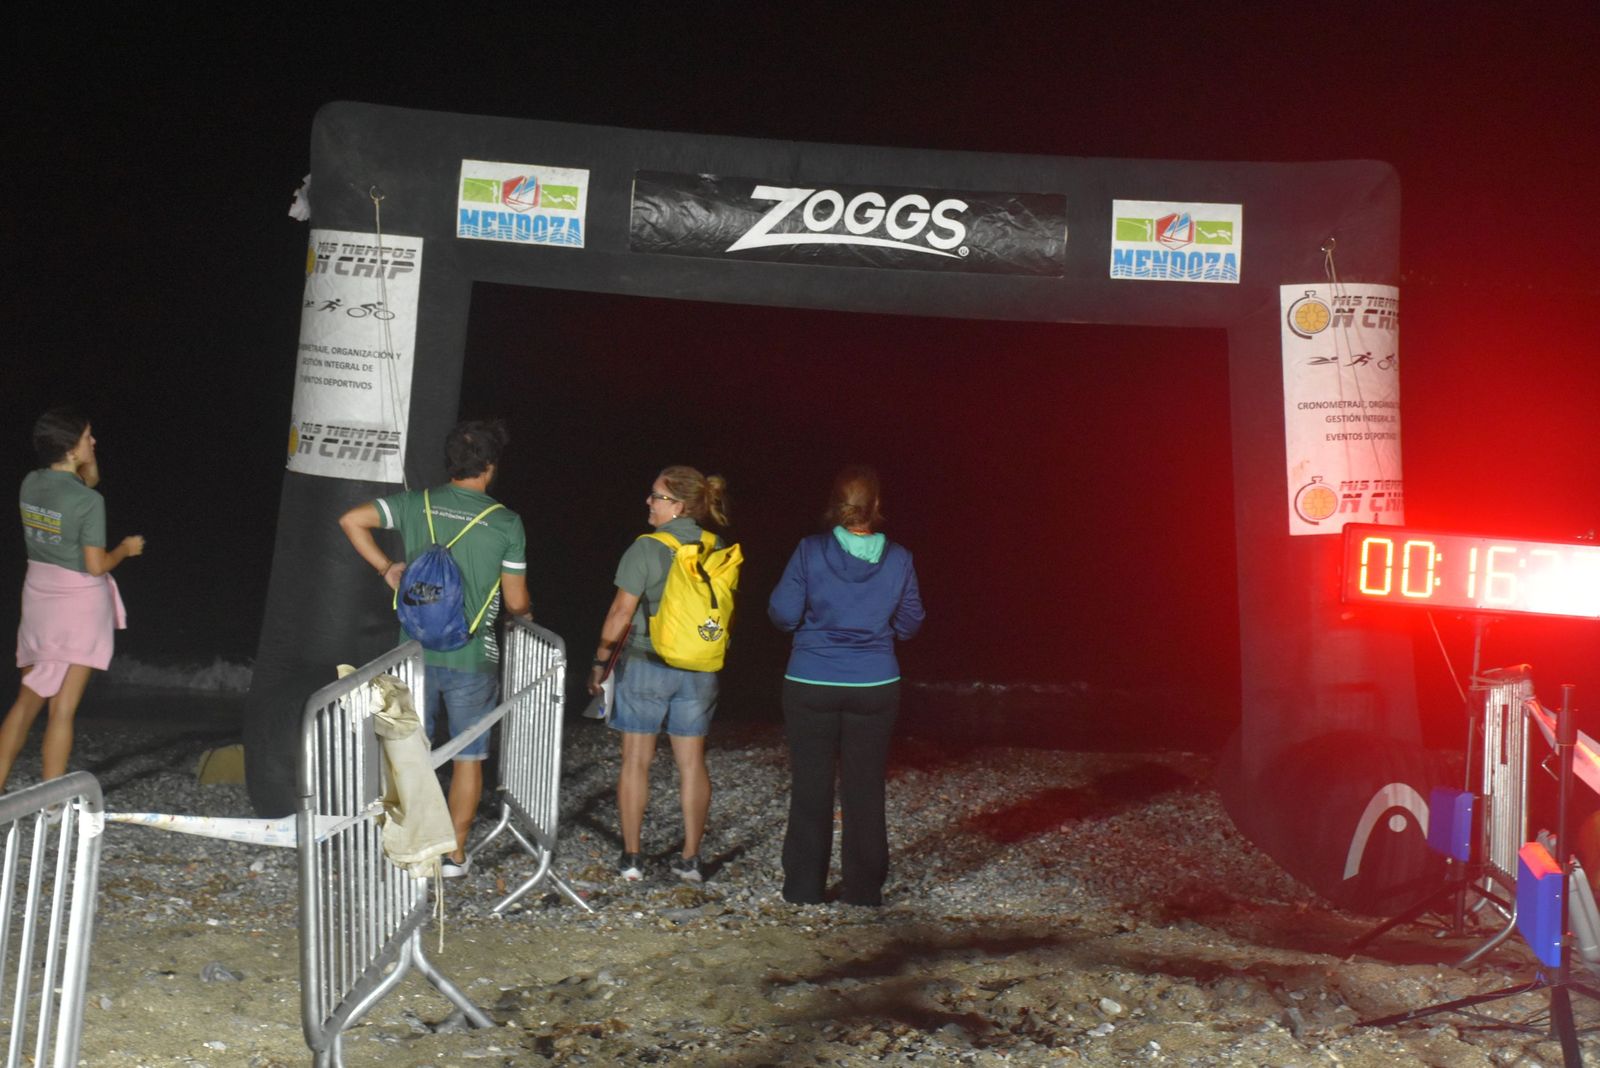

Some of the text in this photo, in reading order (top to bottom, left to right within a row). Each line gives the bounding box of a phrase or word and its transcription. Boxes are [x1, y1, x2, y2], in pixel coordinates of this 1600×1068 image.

[458, 207, 582, 246] MENDOZA
[316, 241, 416, 260] MIS TIEMPOS
[334, 256, 415, 280] CHIP
[1112, 249, 1238, 281] MENDOZA
[1331, 295, 1362, 306] MIS
[395, 352, 402, 360] Y
[324, 360, 360, 371] INTEGRAL
[362, 364, 373, 372] DE
[324, 377, 373, 390] DEPORTIVOS
[1325, 414, 1361, 423] GESTIÓN
[301, 421, 401, 441] MIS TIEMPOS
[1325, 431, 1363, 441] EVENTOS
[319, 437, 400, 462] CHIP
[1340, 480, 1370, 491] MIS
